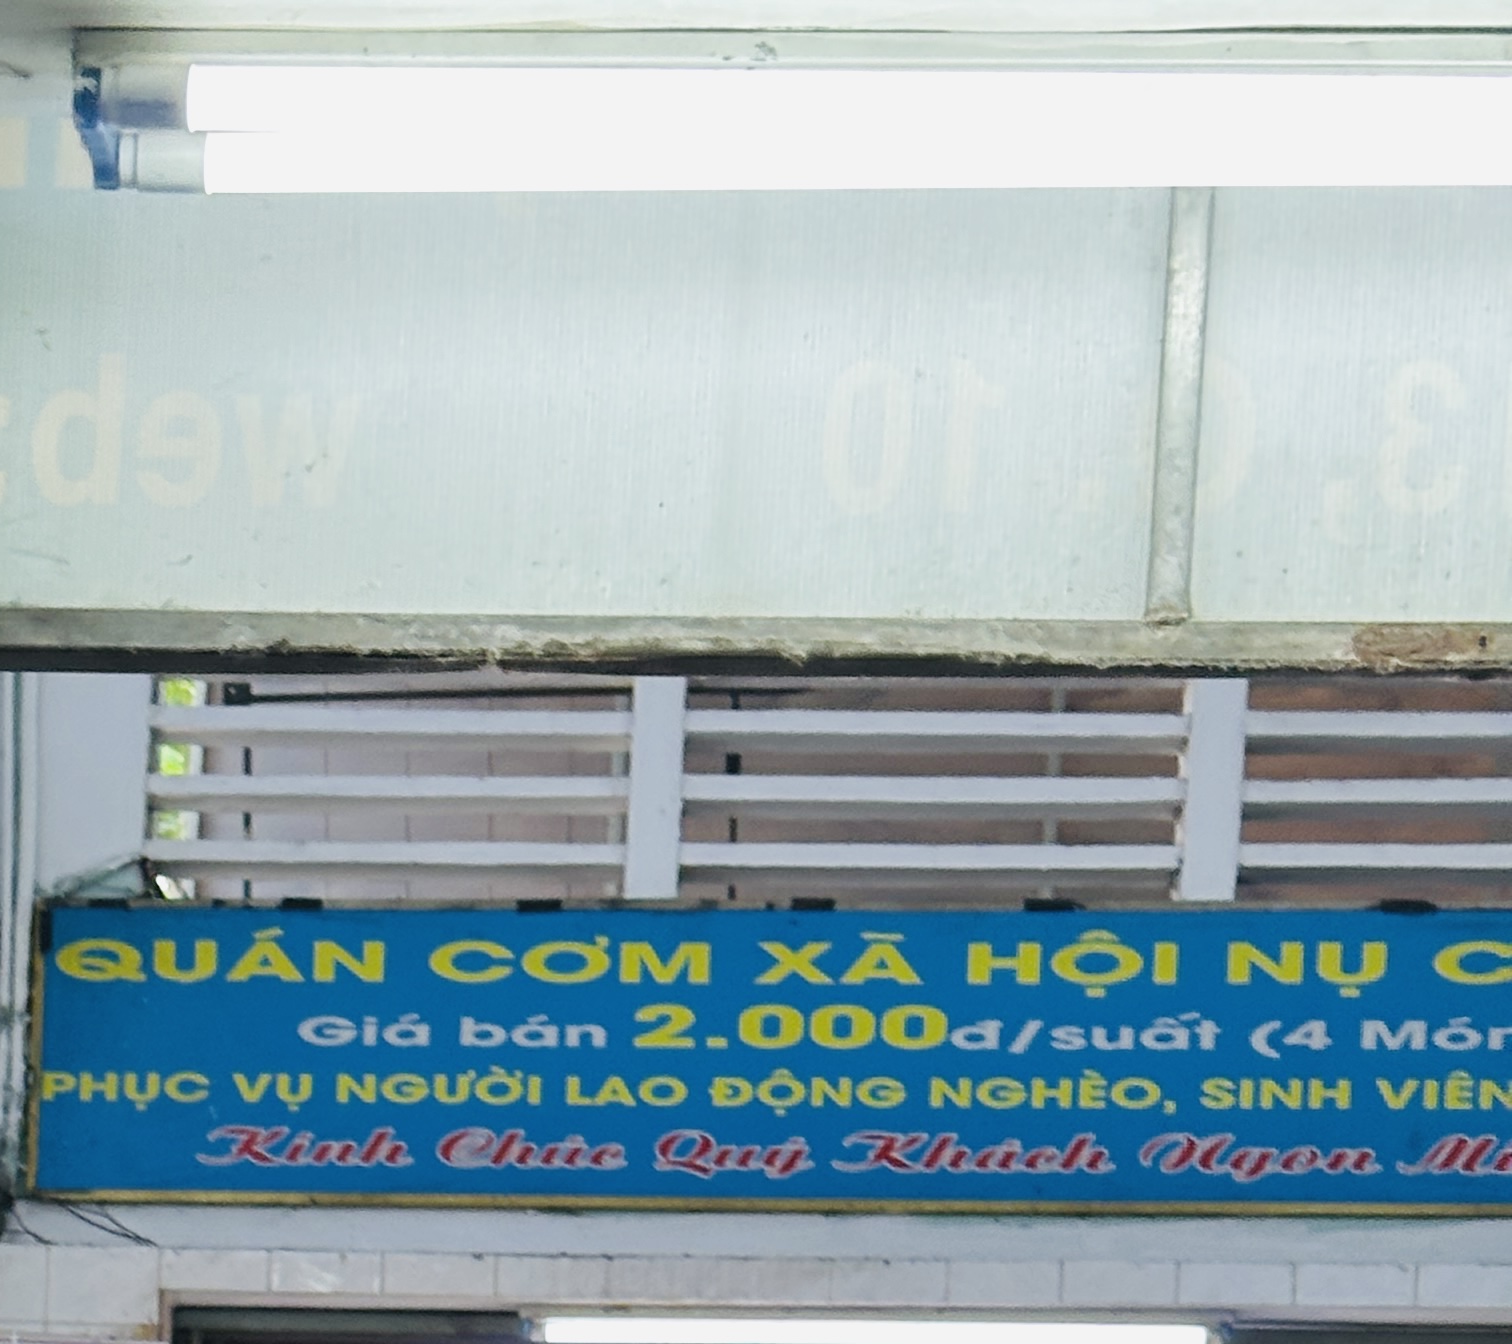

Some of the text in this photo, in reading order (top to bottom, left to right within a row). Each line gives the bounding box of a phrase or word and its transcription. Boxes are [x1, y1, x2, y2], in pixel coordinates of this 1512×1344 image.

[55, 926, 387, 984] QUÁN
[428, 933, 712, 985] CƠM
[754, 931, 924, 985] XÃ
[965, 930, 1180, 999] HỘI
[1226, 940, 1389, 998] NỤ
[297, 1012, 432, 1048] Giá
[459, 1013, 608, 1048] bán
[633, 1002, 1222, 1054] 2.000đ/suất
[1249, 1018, 1333, 1060] (4
[42, 1064, 1512, 1117] PHỤC VỤ NGƯỜI LAO ĐỘNG NGHÈO, SINH VIÊN
[651, 1130, 815, 1180] Quý
[830, 1129, 1116, 1174] Khách
[1138, 1131, 1383, 1184] Ngon
